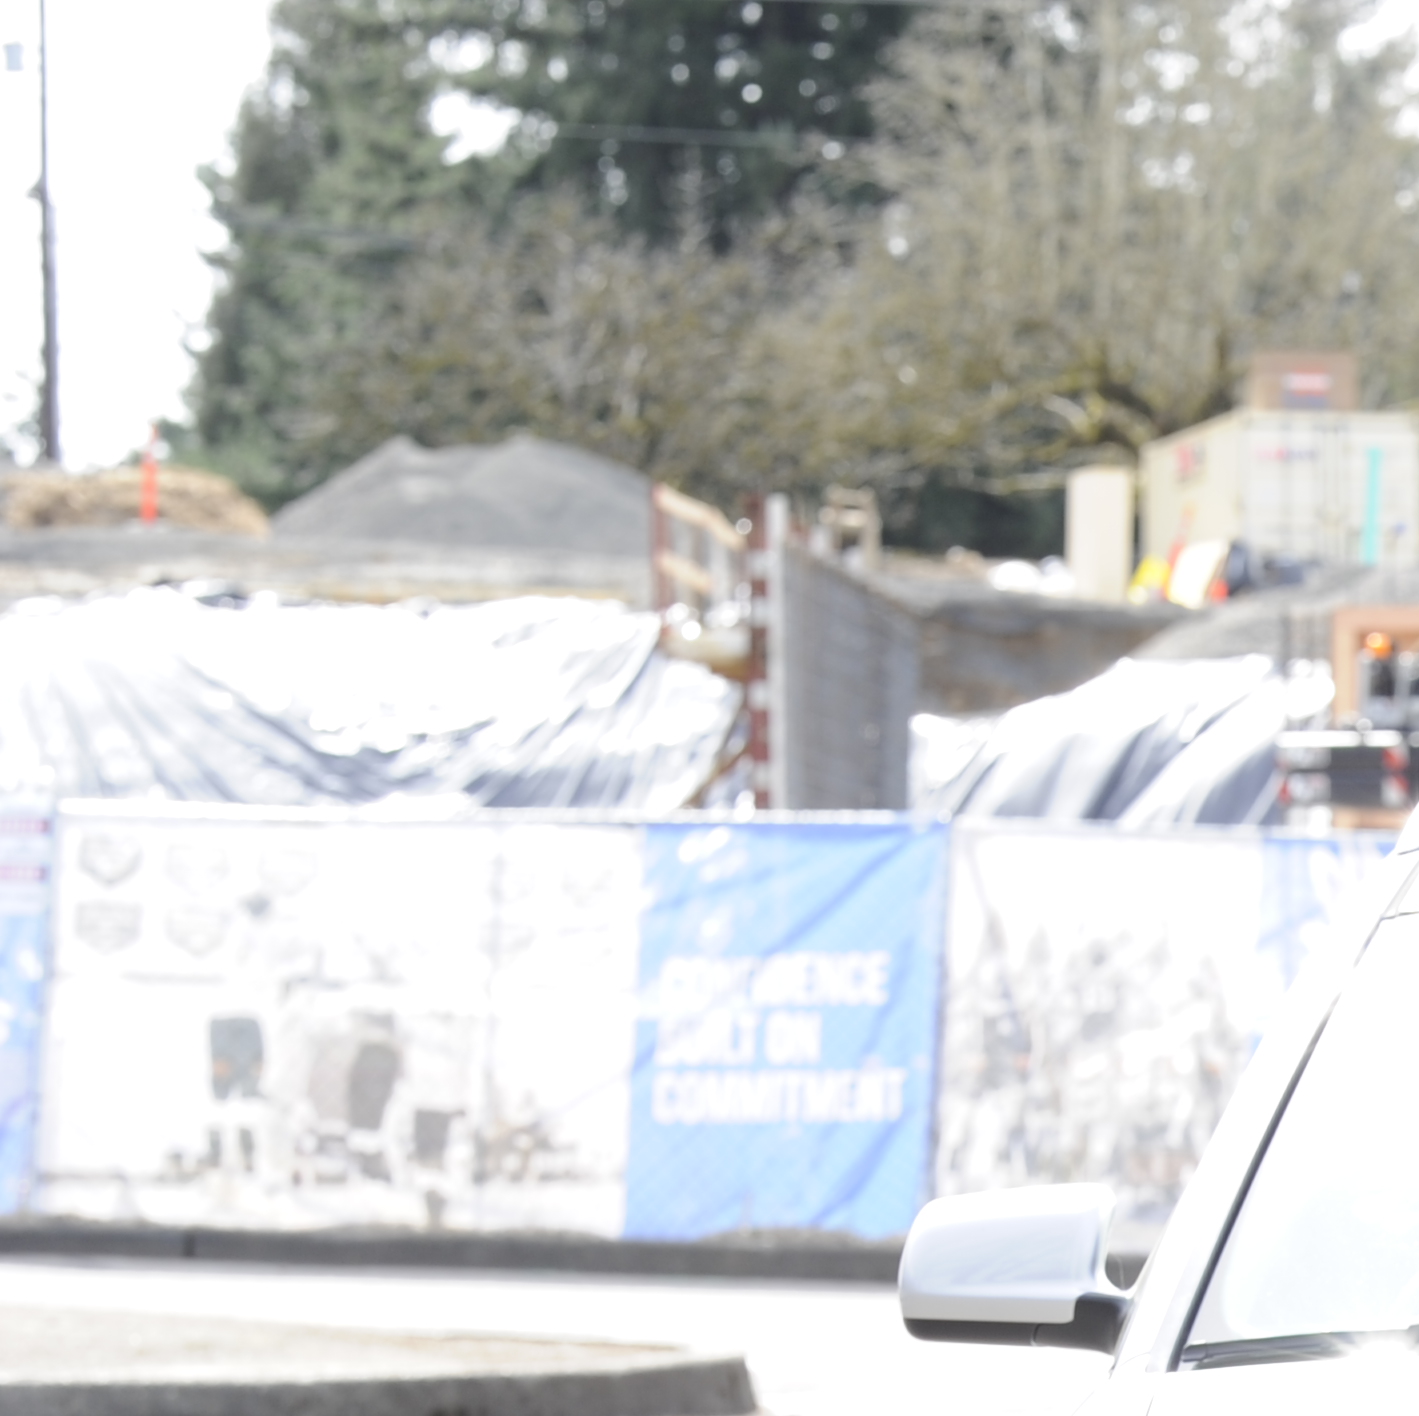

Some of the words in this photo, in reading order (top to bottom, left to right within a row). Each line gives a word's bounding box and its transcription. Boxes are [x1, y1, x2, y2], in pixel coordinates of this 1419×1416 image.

[661, 951, 890, 1008] CONDENCE
[765, 1010, 822, 1064] ON
[653, 1069, 907, 1124] COMMITMENT
